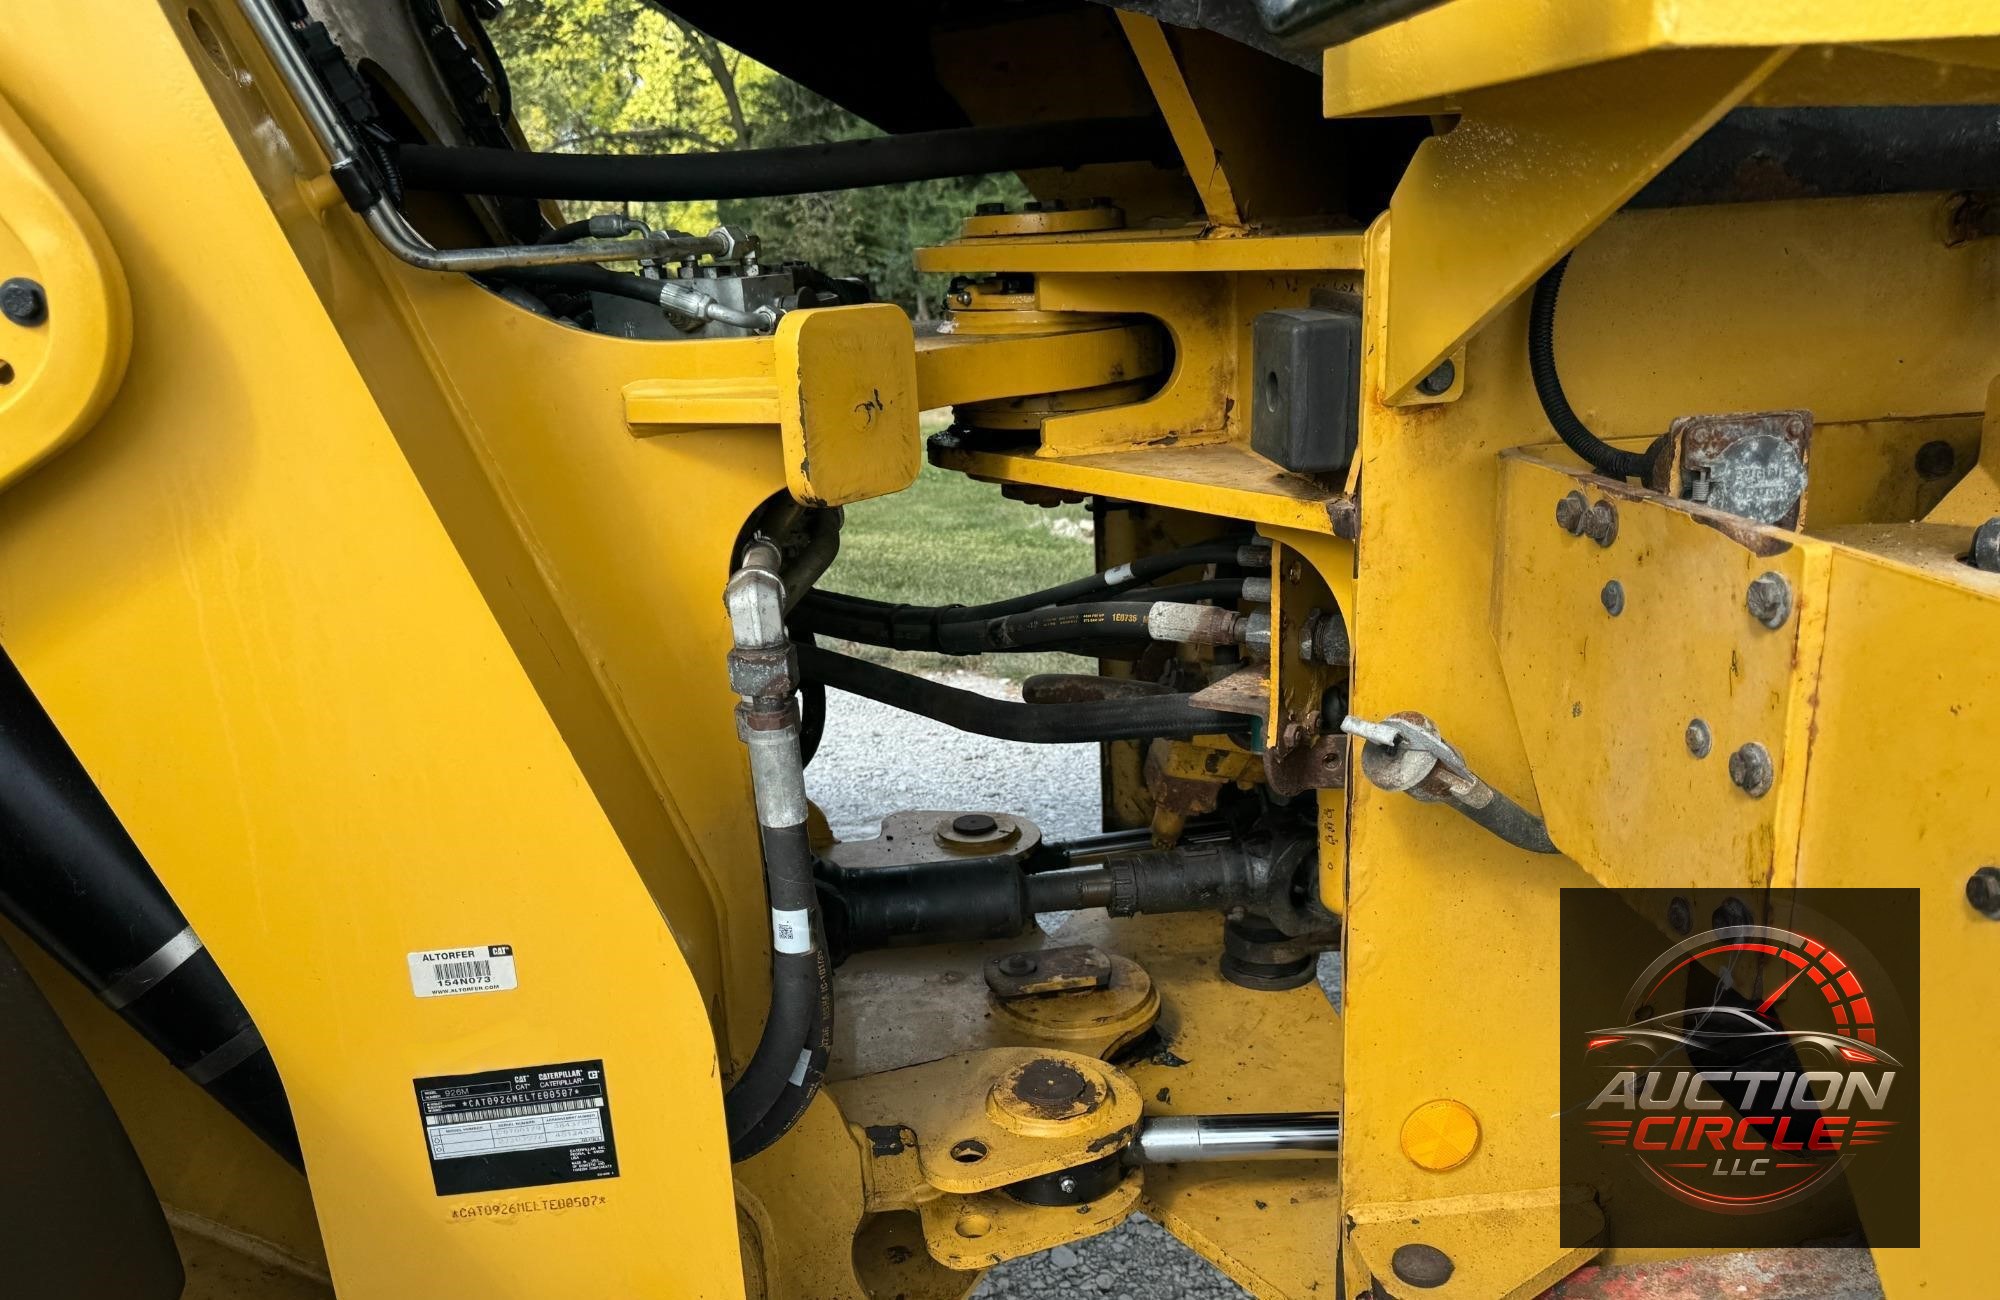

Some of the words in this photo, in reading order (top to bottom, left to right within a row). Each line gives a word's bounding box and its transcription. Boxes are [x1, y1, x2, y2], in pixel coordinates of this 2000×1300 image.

[422, 950, 475, 962] ALTORFER
[492, 947, 507, 956] CAT
[437, 976, 492, 987] 154N073
[514, 1075, 527, 1083] CAT
[538, 1070, 581, 1081] CATERPILLAR
[540, 1078, 582, 1088] CATERPILLAR
[444, 1088, 470, 1097] 926M
